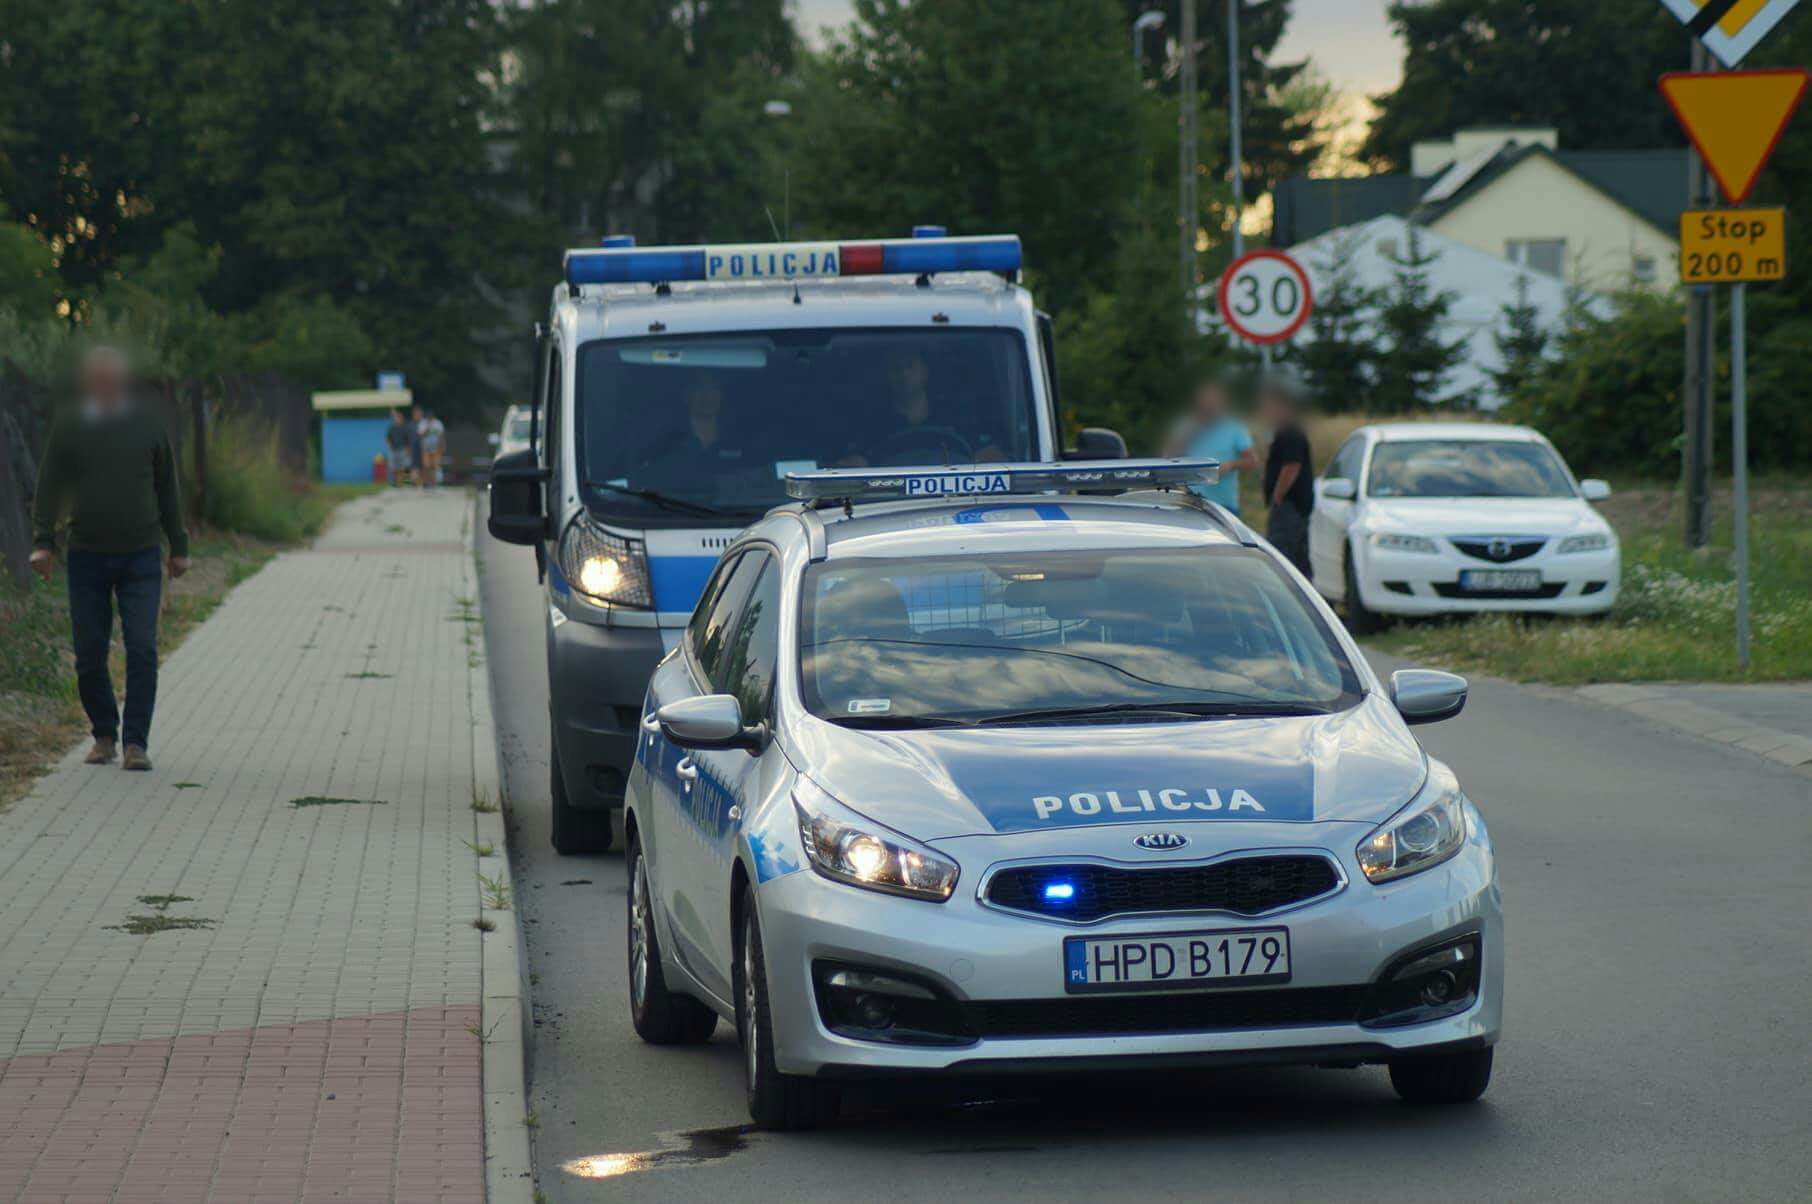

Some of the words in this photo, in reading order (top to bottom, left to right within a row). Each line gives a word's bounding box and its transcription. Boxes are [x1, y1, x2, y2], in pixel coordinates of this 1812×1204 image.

[1700, 215, 1766, 245] Stop
[708, 252, 837, 277] POLICJA
[1688, 252, 1742, 277] 200
[1757, 257, 1779, 275] m
[1236, 275, 1297, 316] 30
[908, 475, 1007, 495] POLICJA
[1032, 788, 1266, 820] POLICJA
[1143, 834, 1181, 847] KIA
[1094, 942, 1176, 982] HPD
[1189, 936, 1281, 978] B179
[1071, 969, 1086, 981] PL
